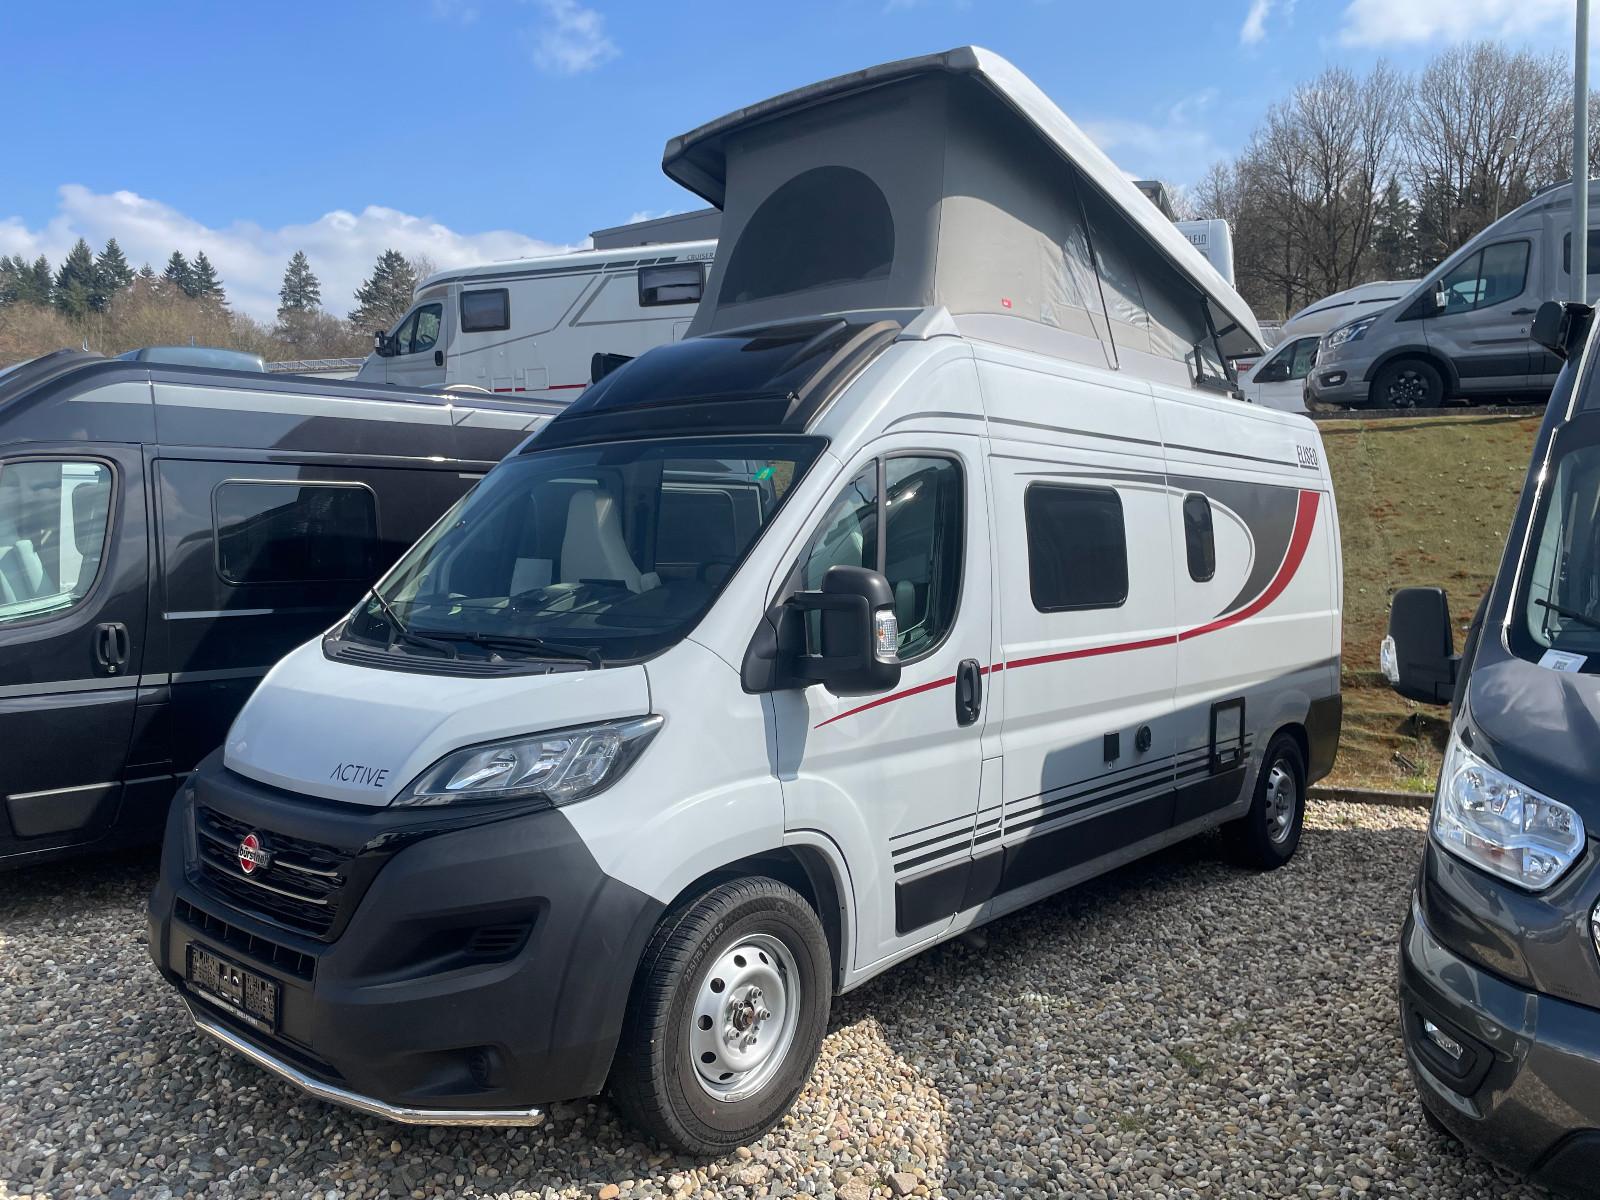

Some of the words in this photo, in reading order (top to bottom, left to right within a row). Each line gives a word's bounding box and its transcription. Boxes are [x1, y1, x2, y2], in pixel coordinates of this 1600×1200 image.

[687, 252, 714, 261] CRUISER
[1296, 444, 1318, 466] ELISEO
[329, 762, 390, 788] ACTIVE
